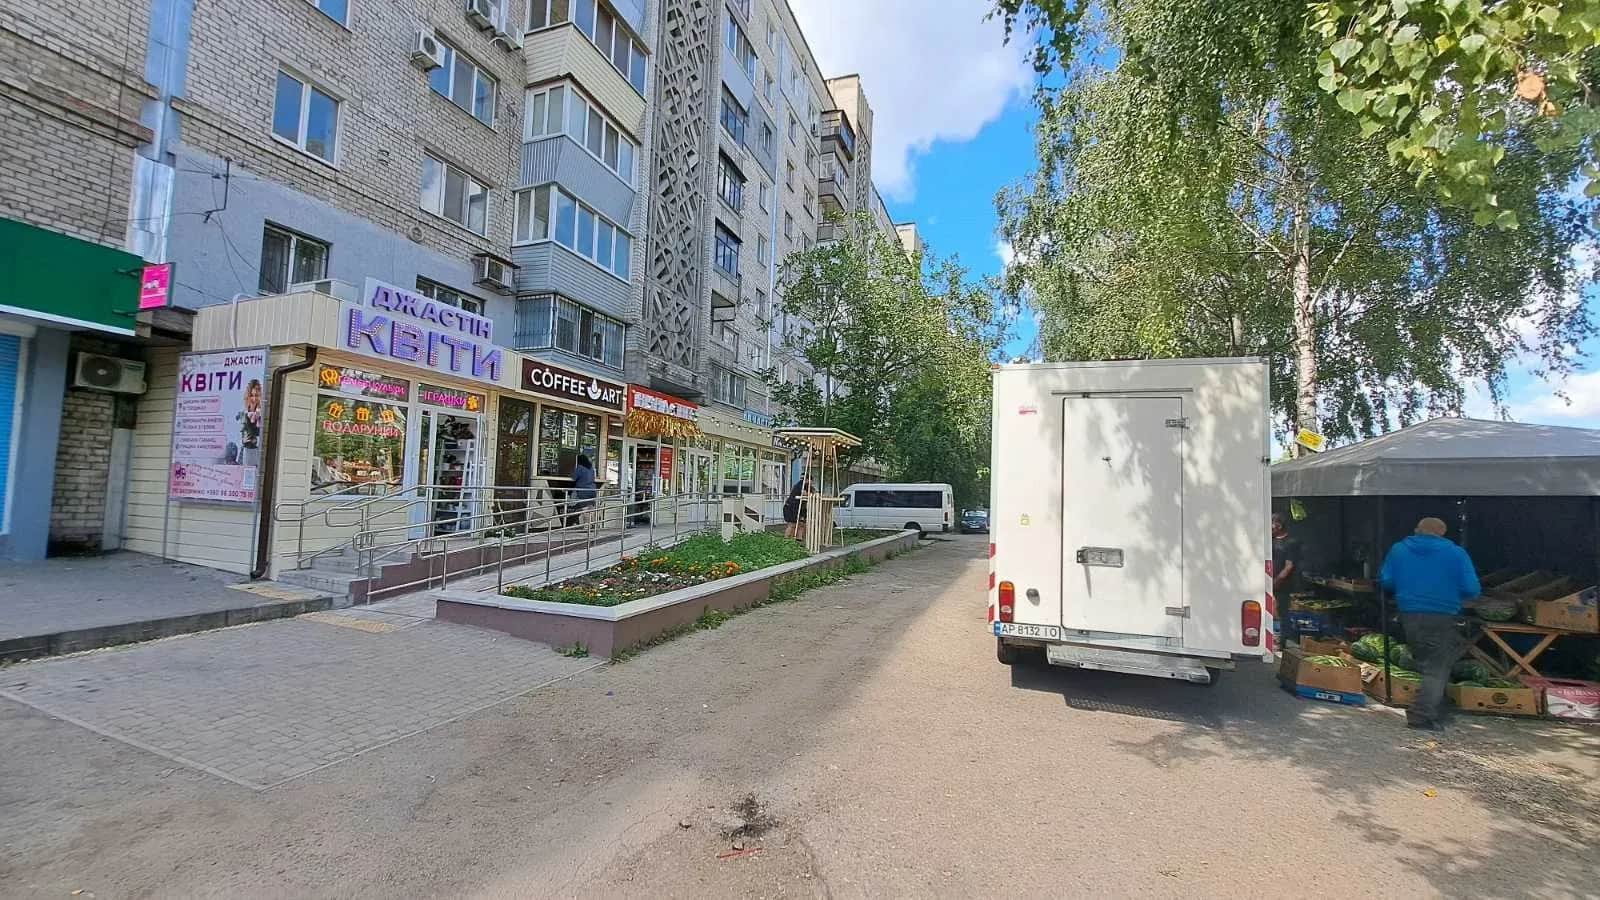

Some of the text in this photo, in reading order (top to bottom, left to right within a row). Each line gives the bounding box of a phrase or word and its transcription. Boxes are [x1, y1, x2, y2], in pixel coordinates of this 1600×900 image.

[372, 286, 491, 339] ДЖАСТІН
[348, 308, 503, 381] КВІТИ
[224, 355, 263, 367] ДЖАСТІН
[182, 370, 242, 392] КВІТИ
[531, 368, 622, 405] COFFEE ART
[424, 391, 466, 407] ІГРАШКИ
[322, 420, 400, 438] ПОДАРУНКИ
[1002, 624, 1057, 637] AP 8132 IO
